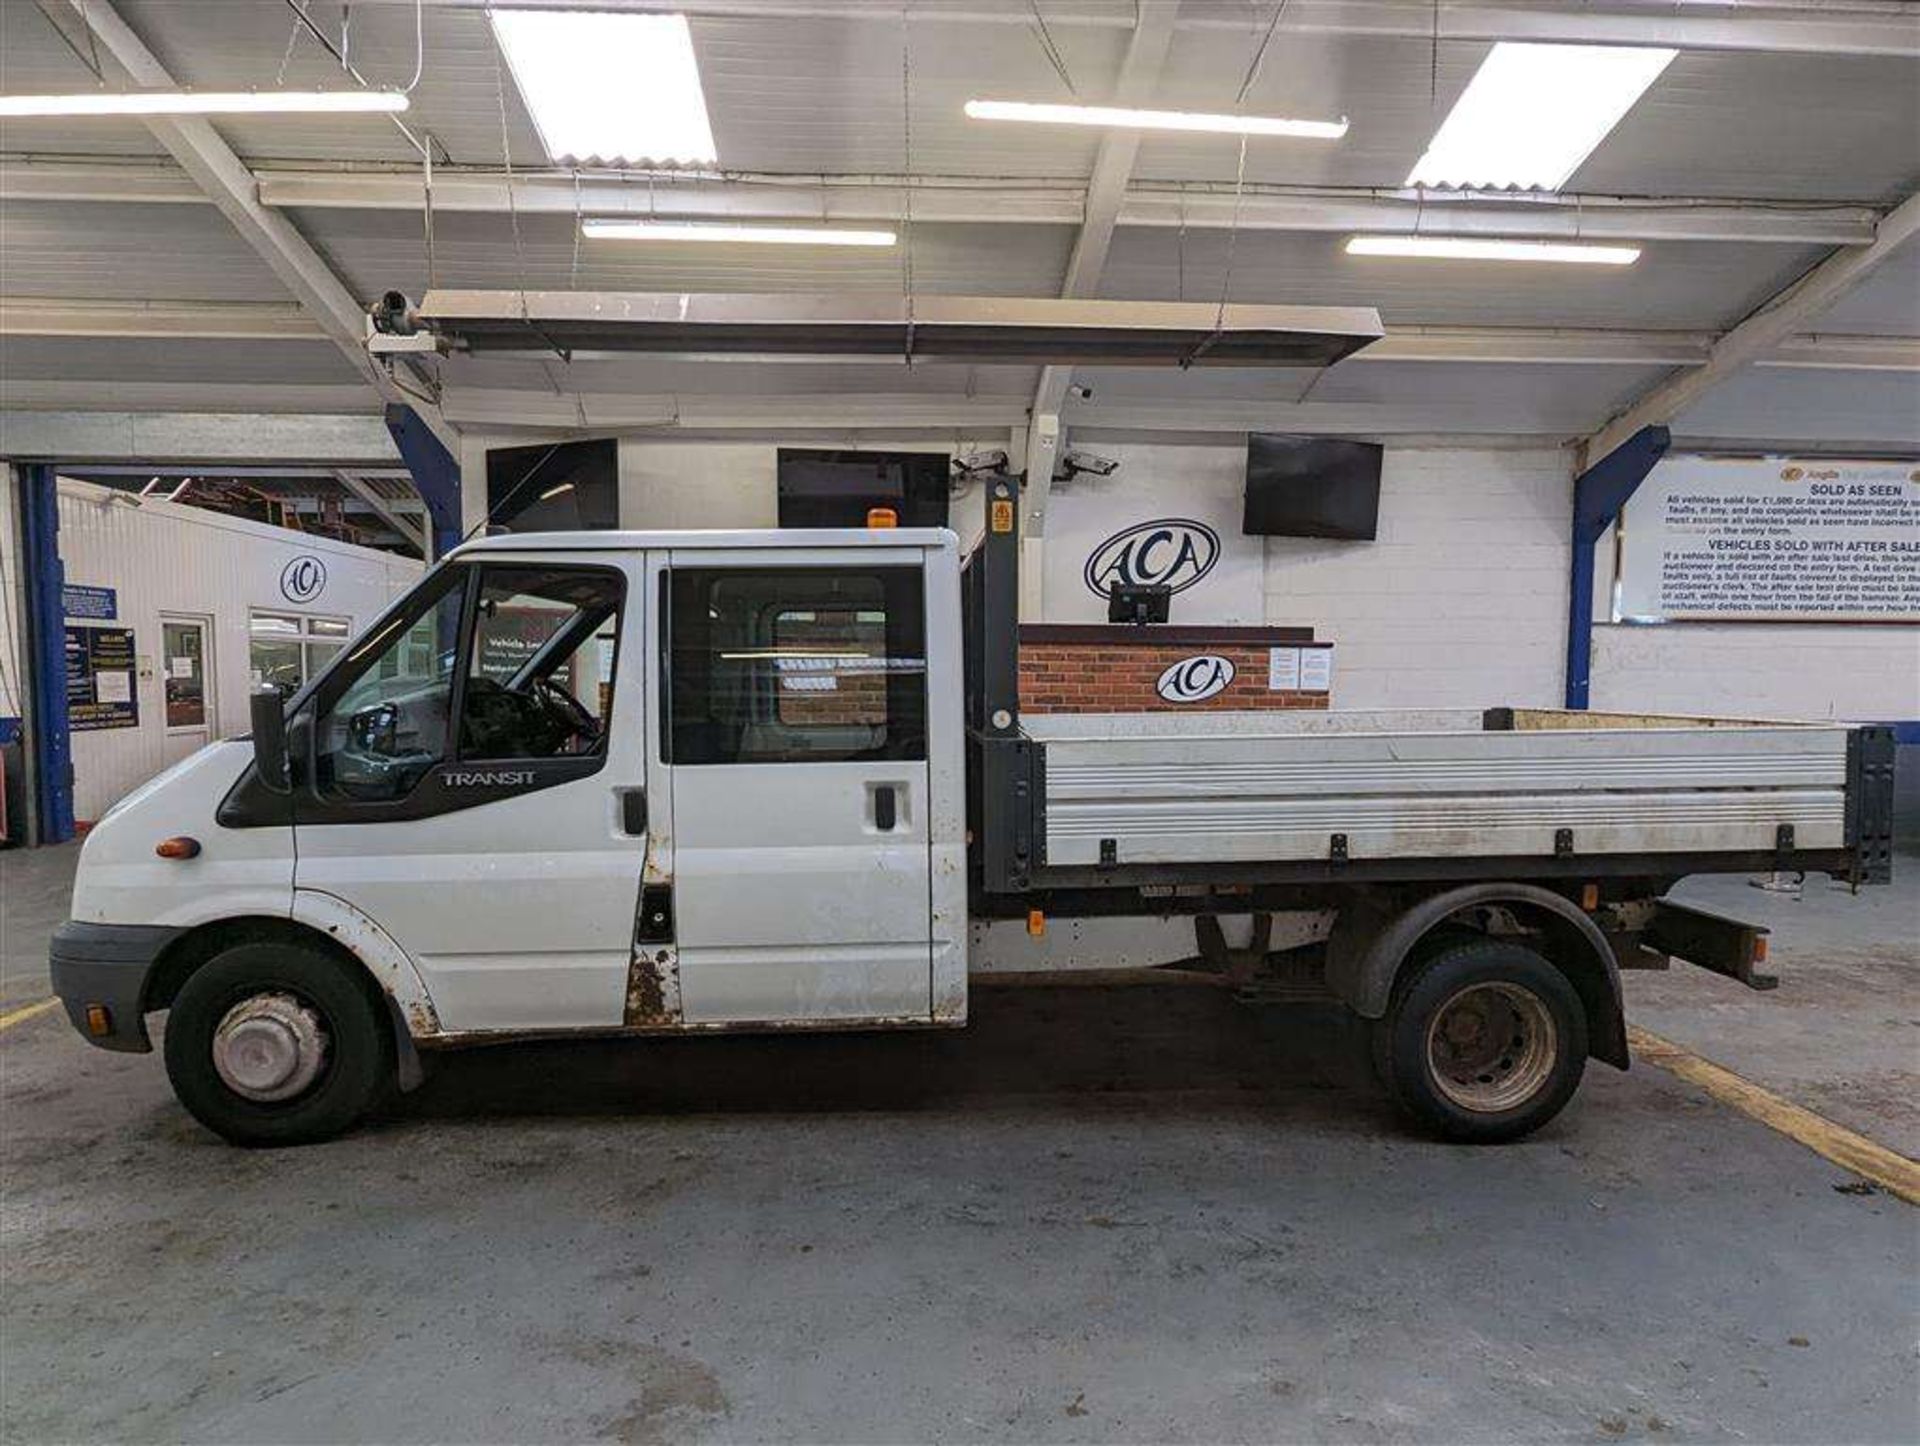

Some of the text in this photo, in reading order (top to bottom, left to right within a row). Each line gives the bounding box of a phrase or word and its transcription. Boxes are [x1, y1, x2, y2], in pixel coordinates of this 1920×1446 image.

[1810, 483, 1902, 495] SOLD AS SEEN
[1667, 494, 1679, 503] All
[1682, 495, 1720, 504] vehicles
[1723, 495, 1743, 504] sold
[1746, 495, 1760, 504] for
[1807, 497, 1826, 506] less
[1846, 497, 1909, 508] automatically
[1732, 506, 1749, 515] and
[1751, 507, 1764, 515] no
[1766, 506, 1817, 517] complaints
[1820, 507, 1872, 516] whatsoever
[1875, 507, 1897, 516] shall
[1900, 507, 1912, 516] be
[1665, 515, 1914, 526] must assume all vehicles sold as seen have incorrect
[1724, 526, 1738, 534] the
[1741, 526, 1765, 537] entry
[1708, 539, 1771, 551] VEHICLES
[1774, 540, 1808, 551] SOLD
[1812, 541, 1844, 551] WITH
[1847, 541, 1887, 552] AFTER
[1682, 551, 1715, 560] vehicle
[1728, 552, 1749, 561] sold
[1751, 552, 1771, 561] with
[1788, 552, 1809, 562] after
[1811, 553, 1831, 562] sale
[1833, 553, 1850, 562] test
[1881, 553, 1899, 562] this
[1662, 561, 1713, 571] auctioneer
[1715, 562, 1734, 571] and
[1735, 562, 1778, 571] declared
[1793, 562, 1808, 571] the
[1810, 563, 1834, 574] entry
[1863, 563, 1870, 572] A
[1872, 564, 1890, 573] test
[1893, 564, 1915, 573] drive
[1662, 571, 1689, 580] faults
[1724, 572, 1739, 581] full
[1742, 572, 1757, 581] list
[1759, 572, 1769, 581] of
[1771, 572, 1797, 581] faults
[1799, 573, 1837, 582] covered
[1849, 573, 1894, 584] displayed
[1662, 581, 1719, 590] auctioneer's
[1751, 582, 1768, 591] The
[1771, 582, 1792, 592] after
[1794, 583, 1813, 592] sale
[1816, 583, 1834, 592] test
[1835, 583, 1859, 592] drive
[1862, 584, 1885, 592] must
[1887, 584, 1899, 592] be
[1662, 591, 1672, 600] of
[1700, 592, 1728, 601] within
[1731, 593, 1749, 601] one
[1751, 592, 1772, 601] hour
[1774, 592, 1796, 602] from
[1799, 592, 1814, 601] the
[1816, 593, 1831, 602] fall
[1833, 593, 1842, 602] of
[1844, 593, 1859, 602] the
[1662, 601, 1715, 611] mechanical
[1717, 602, 1752, 611] defects
[1755, 602, 1778, 611] must
[1780, 602, 1792, 611] be
[1794, 603, 1835, 612] reported
[1837, 603, 1864, 612] within
[1867, 604, 1884, 612] one
[1886, 604, 1908, 612] hour
[490, 638, 524, 649] Vehicle
[1160, 657, 1227, 697] ACA
[440, 771, 537, 787] TRANSIT
